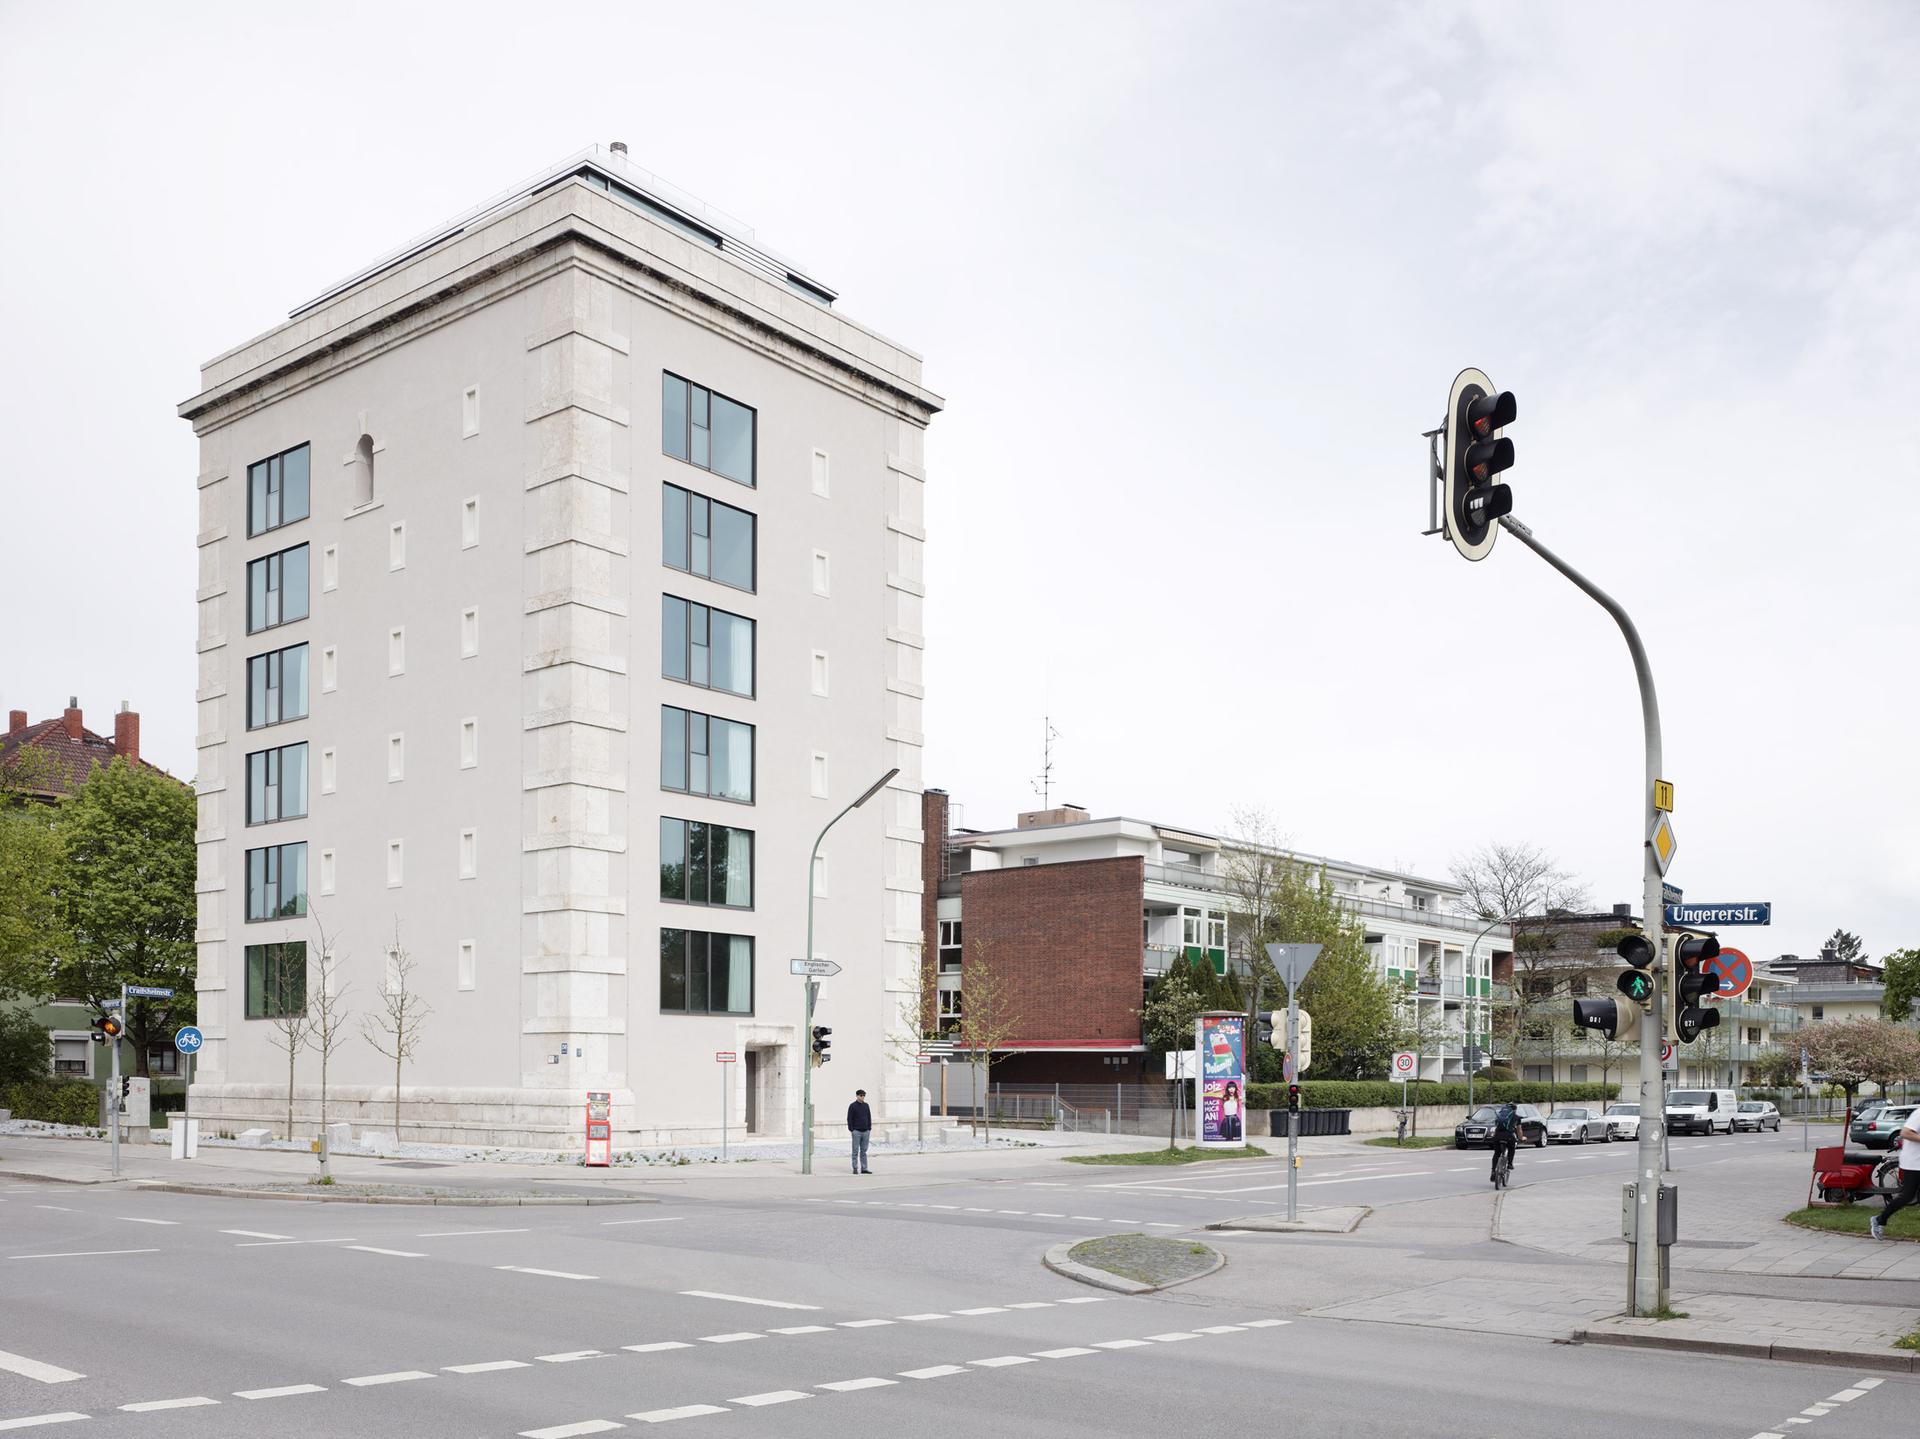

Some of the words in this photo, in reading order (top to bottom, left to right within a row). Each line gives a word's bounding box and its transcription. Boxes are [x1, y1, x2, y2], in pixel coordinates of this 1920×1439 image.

[1661, 785, 1668, 807] 11
[1673, 906, 1758, 924] Ungererstr.
[1400, 1058, 1410, 1067] 30
